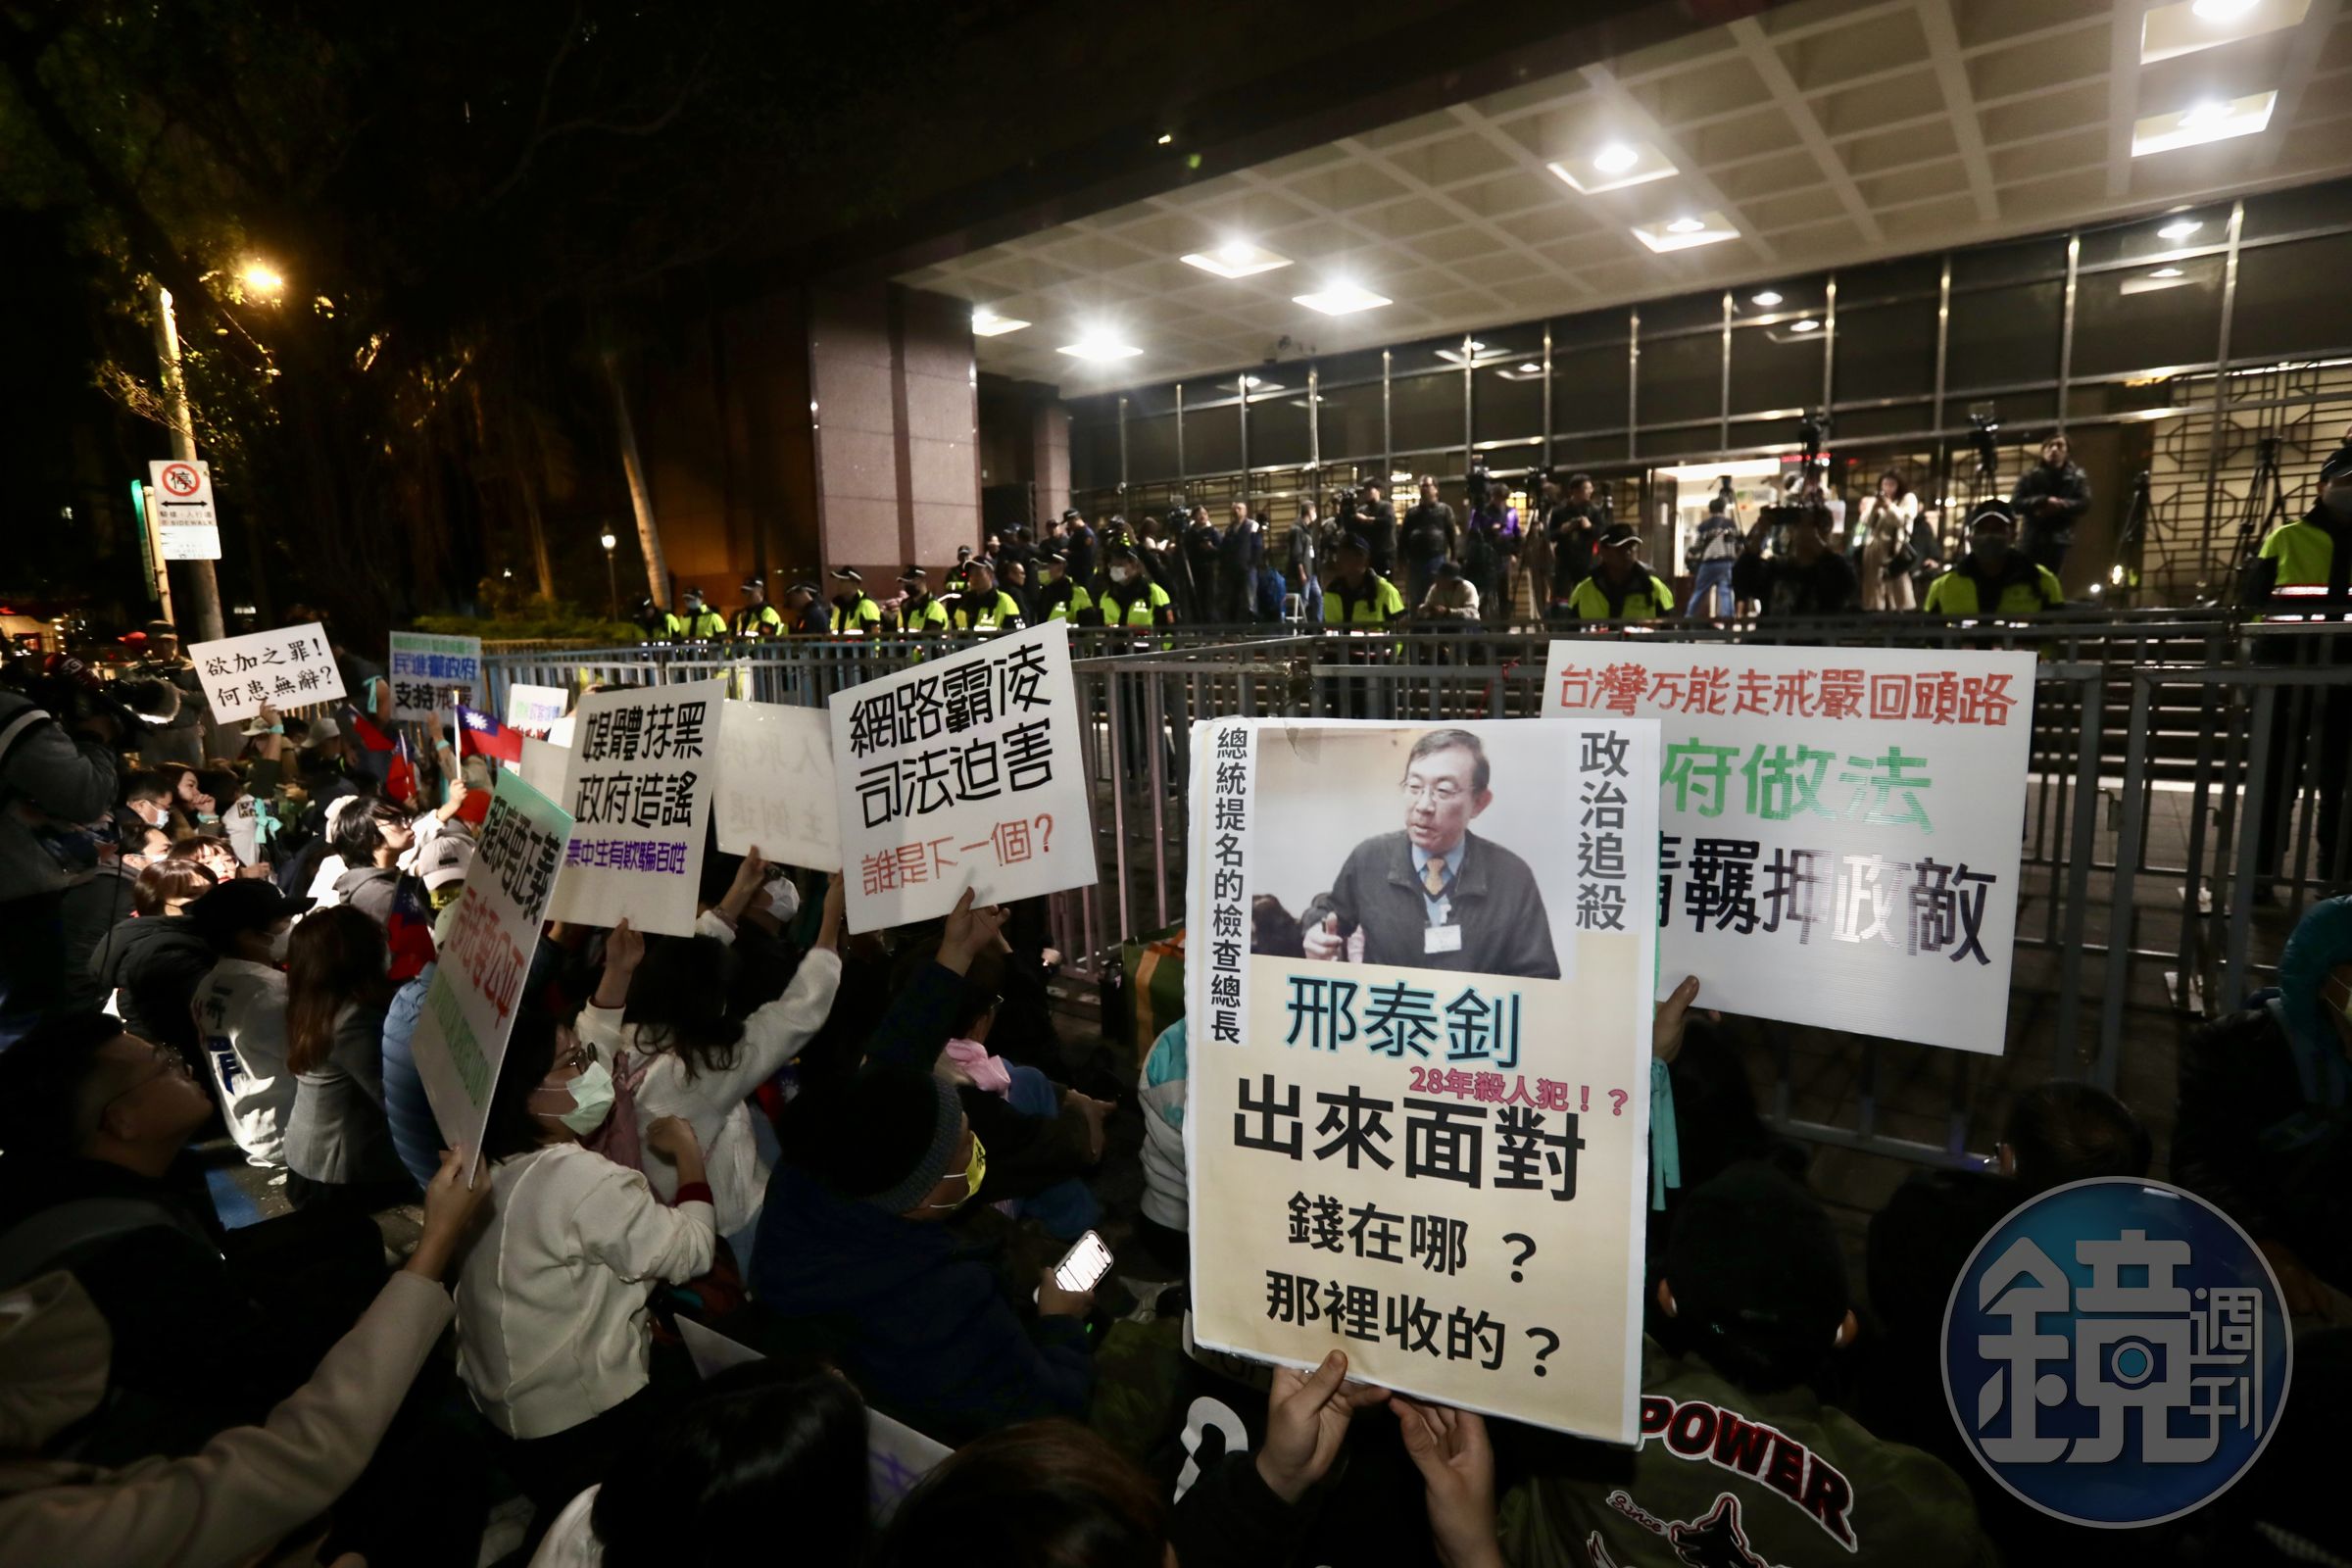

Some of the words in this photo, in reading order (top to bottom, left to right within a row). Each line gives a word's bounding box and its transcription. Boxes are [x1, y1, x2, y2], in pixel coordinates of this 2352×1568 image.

[205, 638, 322, 676] 欲加之罪！
[849, 643, 1052, 759] 網路霸凌
[1559, 662, 2018, 726] 台灣不能走戒嚴回頭路
[582, 701, 707, 761] 媒體抹黑
[855, 717, 1053, 829] 司法迫害
[574, 770, 698, 828] 政府造謠
[1575, 729, 1631, 932] 政治追殺
[478, 795, 561, 926] 程序要正義
[860, 812, 1054, 897] 誰是下一個？
[1210, 726, 1249, 1045] 總統提名的檢查總長
[1659, 831, 1997, 966] 羈押政敵
[1285, 973, 1523, 1069] 邢泰釗
[1234, 1073, 1587, 1202] 出來面對
[1409, 1065, 1629, 1116] 28年殺人犯！？
[1265, 1269, 1561, 1378] 那裡收的？
[1611, 1493, 1664, 1535] Since
